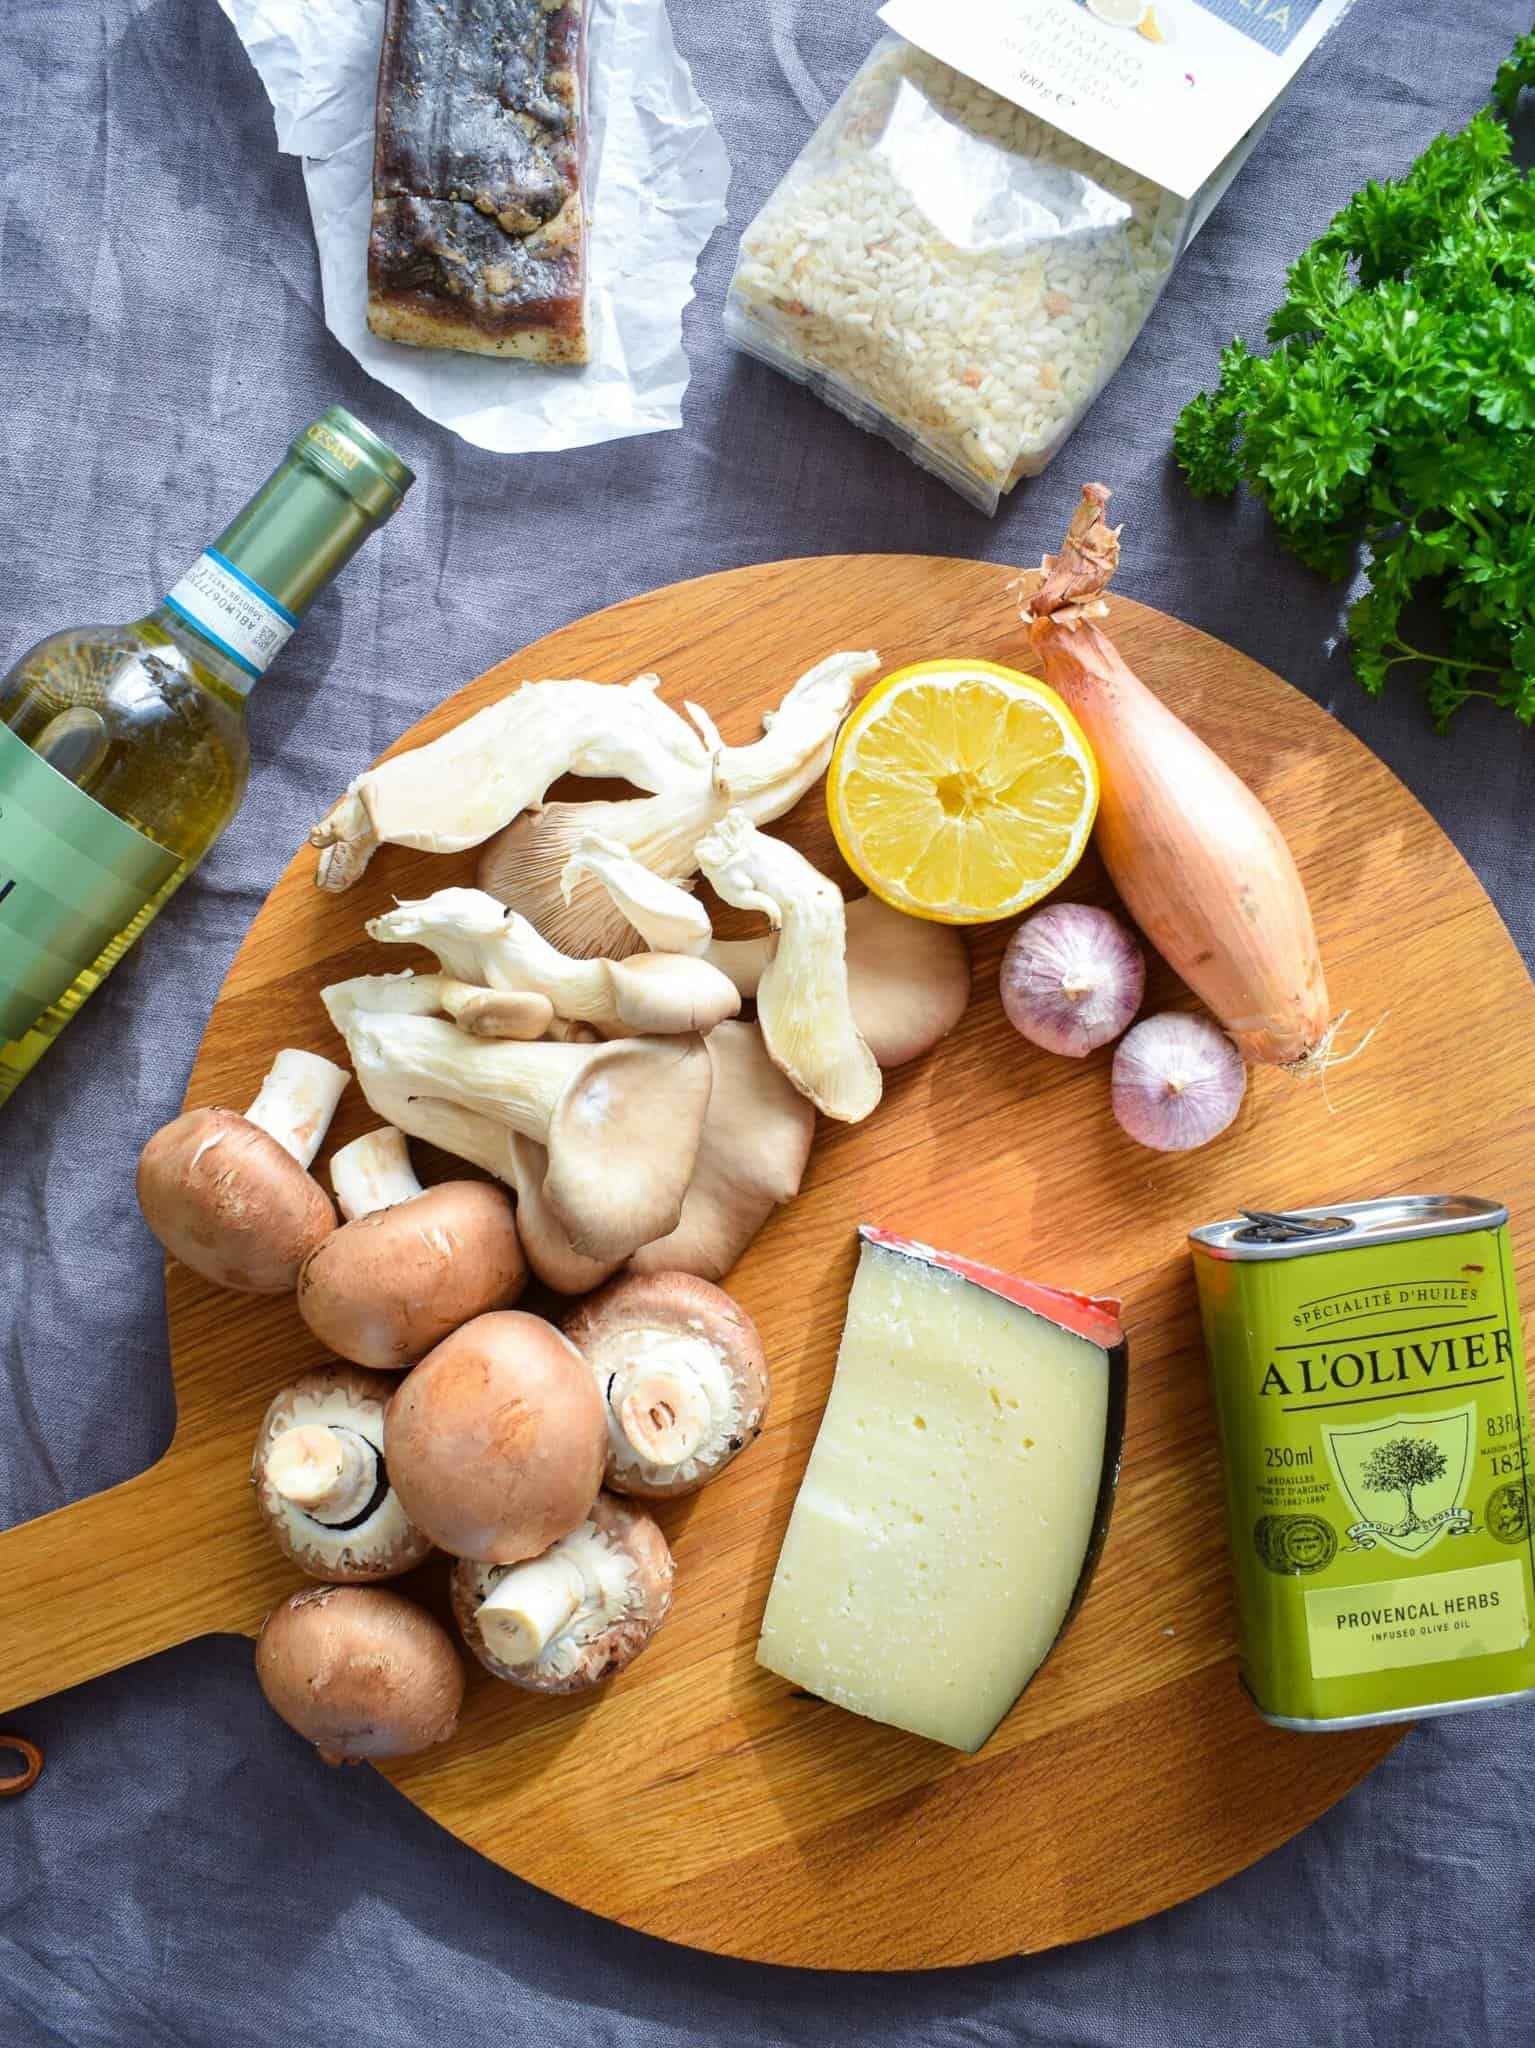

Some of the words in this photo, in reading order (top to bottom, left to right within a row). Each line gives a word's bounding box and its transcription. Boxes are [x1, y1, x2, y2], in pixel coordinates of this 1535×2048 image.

[1400, 1288, 1478, 1303] D'HUILES
[1297, 1328, 1513, 1394] L'OLIVIER
[1264, 1445, 1313, 1467] 250ml
[1336, 1602, 1440, 1629] PROVENCAL
[1444, 1591, 1500, 1615] HERBS
[1371, 1627, 1416, 1642] INFUSED
[1420, 1622, 1449, 1635] OLIVE
[1454, 1620, 1471, 1631] OIL
